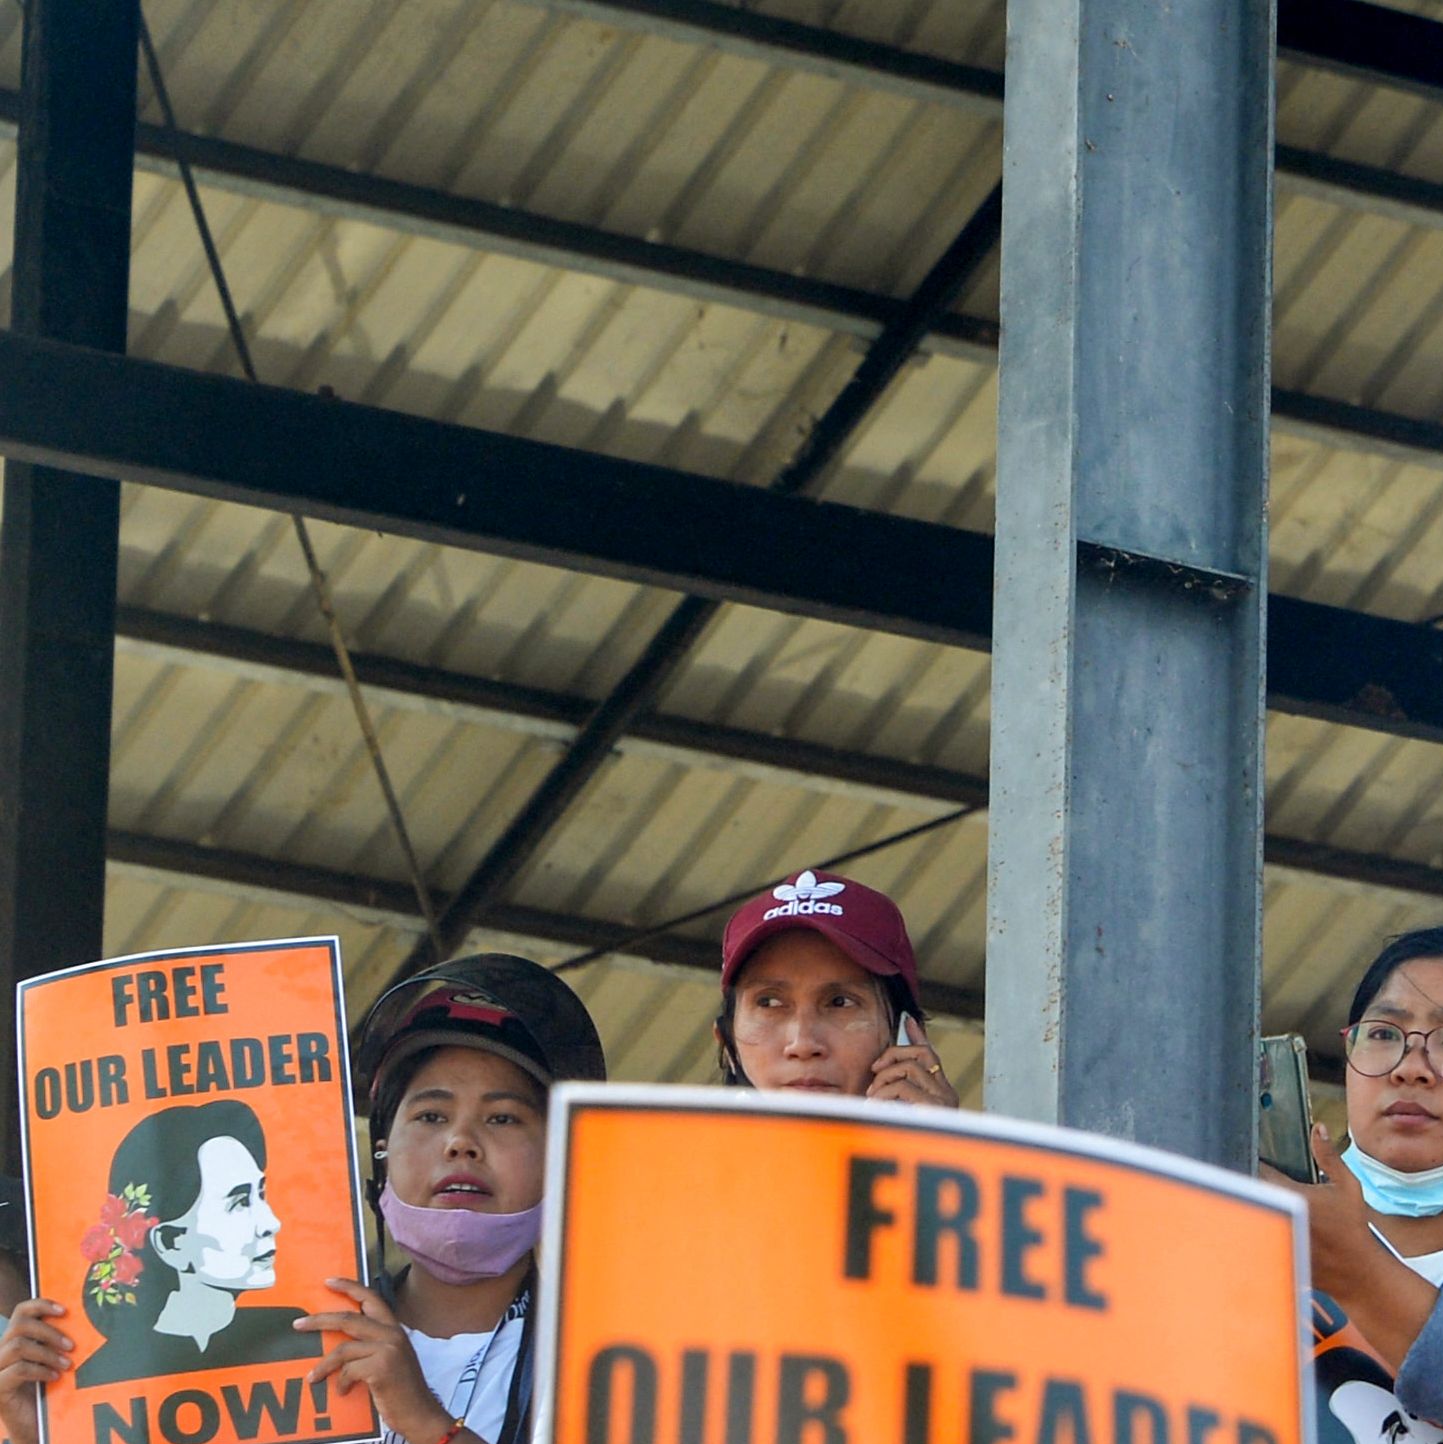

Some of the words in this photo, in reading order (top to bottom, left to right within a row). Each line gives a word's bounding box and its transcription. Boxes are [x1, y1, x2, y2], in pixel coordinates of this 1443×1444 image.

[763, 900, 843, 921] adidas
[112, 963, 230, 1027] FREE
[34, 1062, 131, 1121] OUR
[142, 1031, 332, 1099] LEADER
[840, 1156, 1110, 1312] FREE
